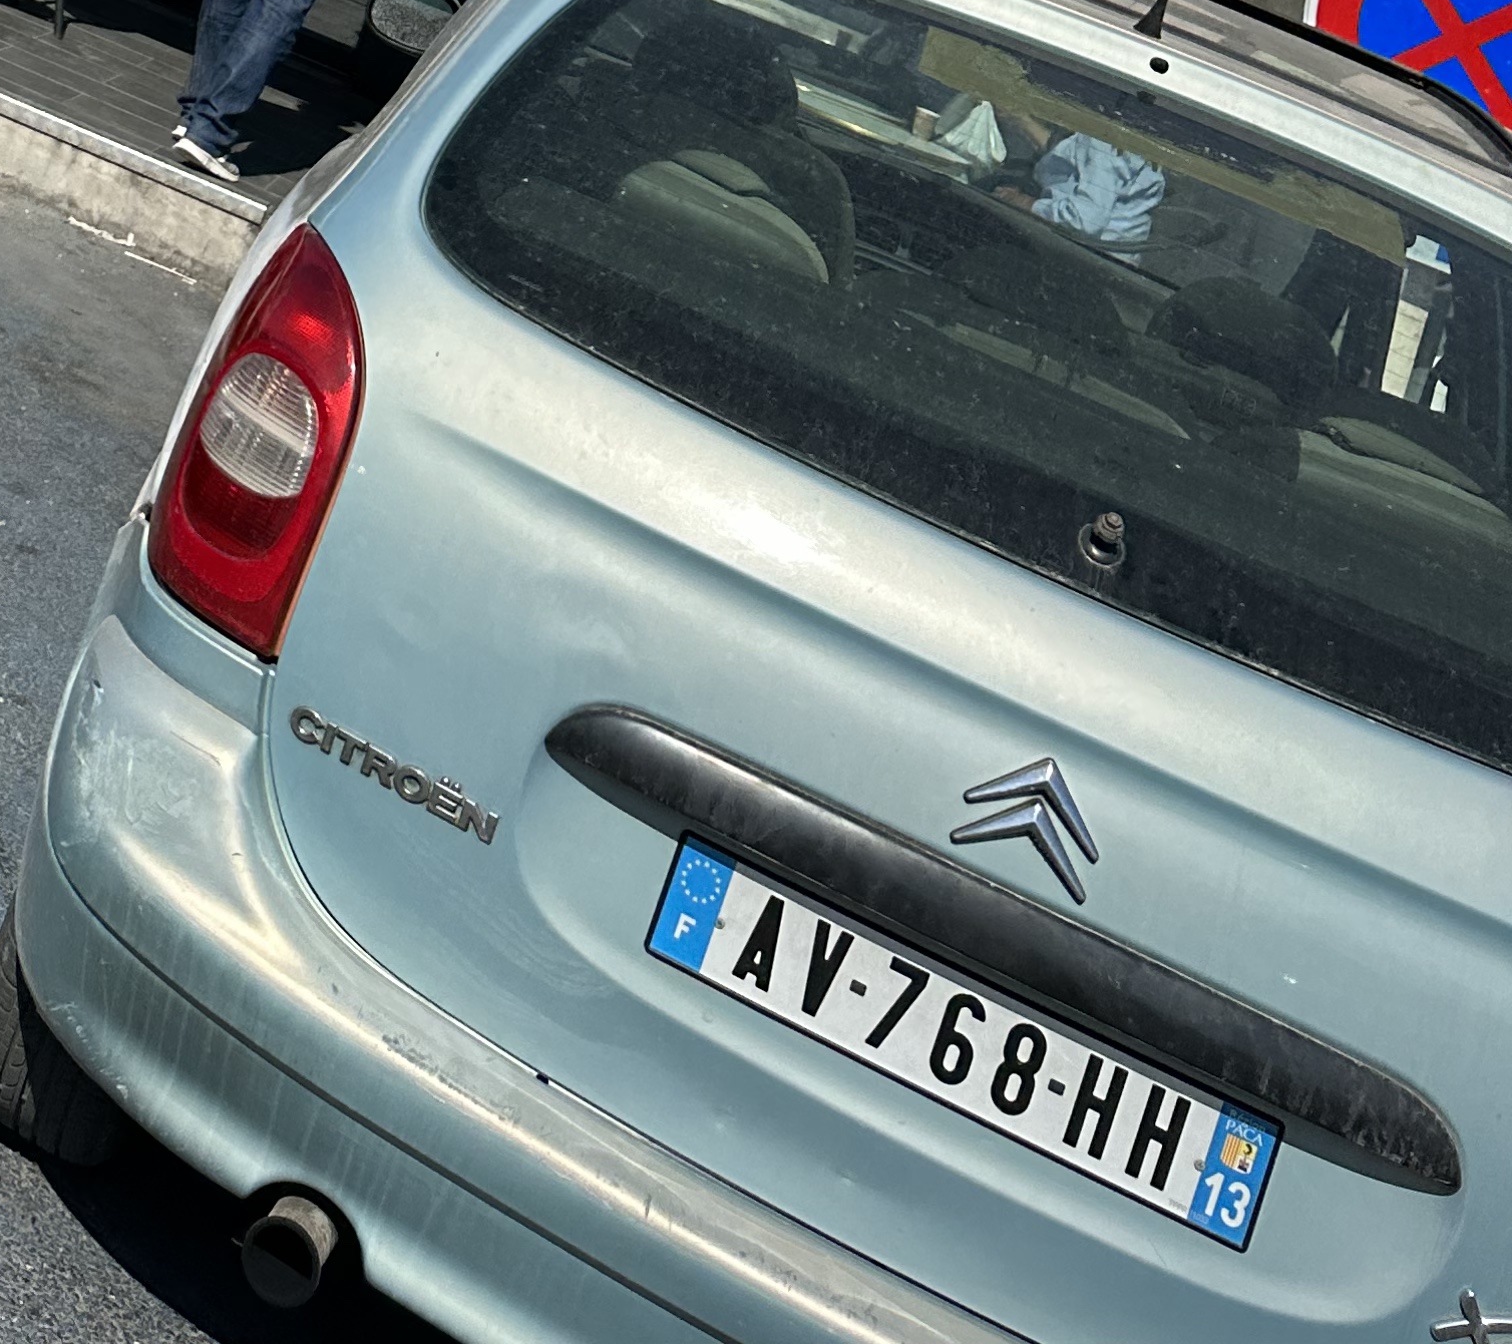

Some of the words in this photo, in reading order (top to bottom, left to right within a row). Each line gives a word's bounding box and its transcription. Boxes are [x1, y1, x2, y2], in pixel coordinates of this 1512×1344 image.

[290, 705, 500, 846] CITROËN
[674, 913, 697, 940] F
[732, 894, 1191, 1192] AV-768-HH
[1225, 1119, 1263, 1147] PACA
[1204, 1171, 1252, 1229] 13
